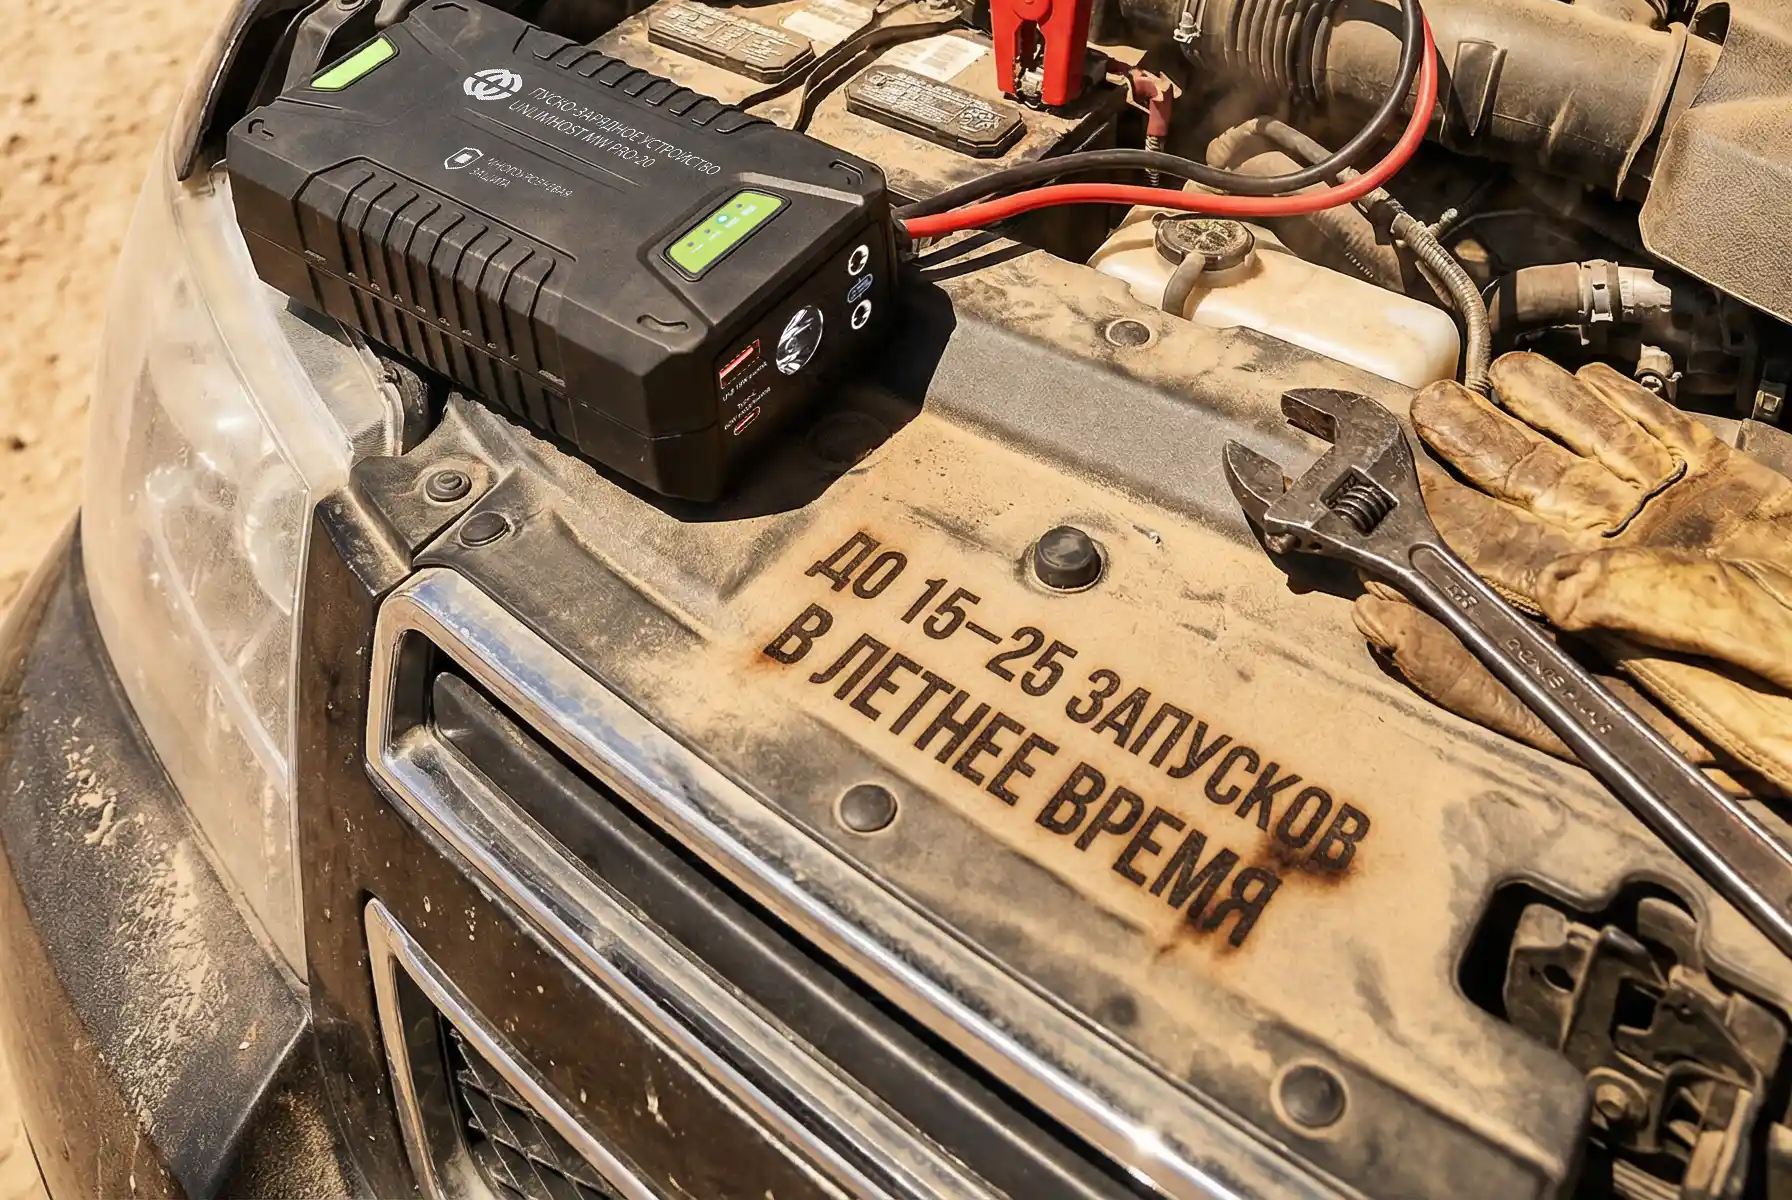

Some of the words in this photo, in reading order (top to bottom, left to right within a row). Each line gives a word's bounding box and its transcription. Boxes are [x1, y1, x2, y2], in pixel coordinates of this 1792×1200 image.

[528, 88, 645, 143] ПУСКО-ЗАРЯДНОЕ
[639, 135, 721, 176] УСТРОЙСТВО
[607, 143, 656, 168] PRO-20
[763, 603, 834, 665] В
[808, 633, 1060, 807] ЛЕТНЕЕ
[1035, 761, 1283, 947] ВРЕМЯ
[804, 531, 908, 599] ДО
[1065, 669, 1371, 874] ЗАПУСКОВ
